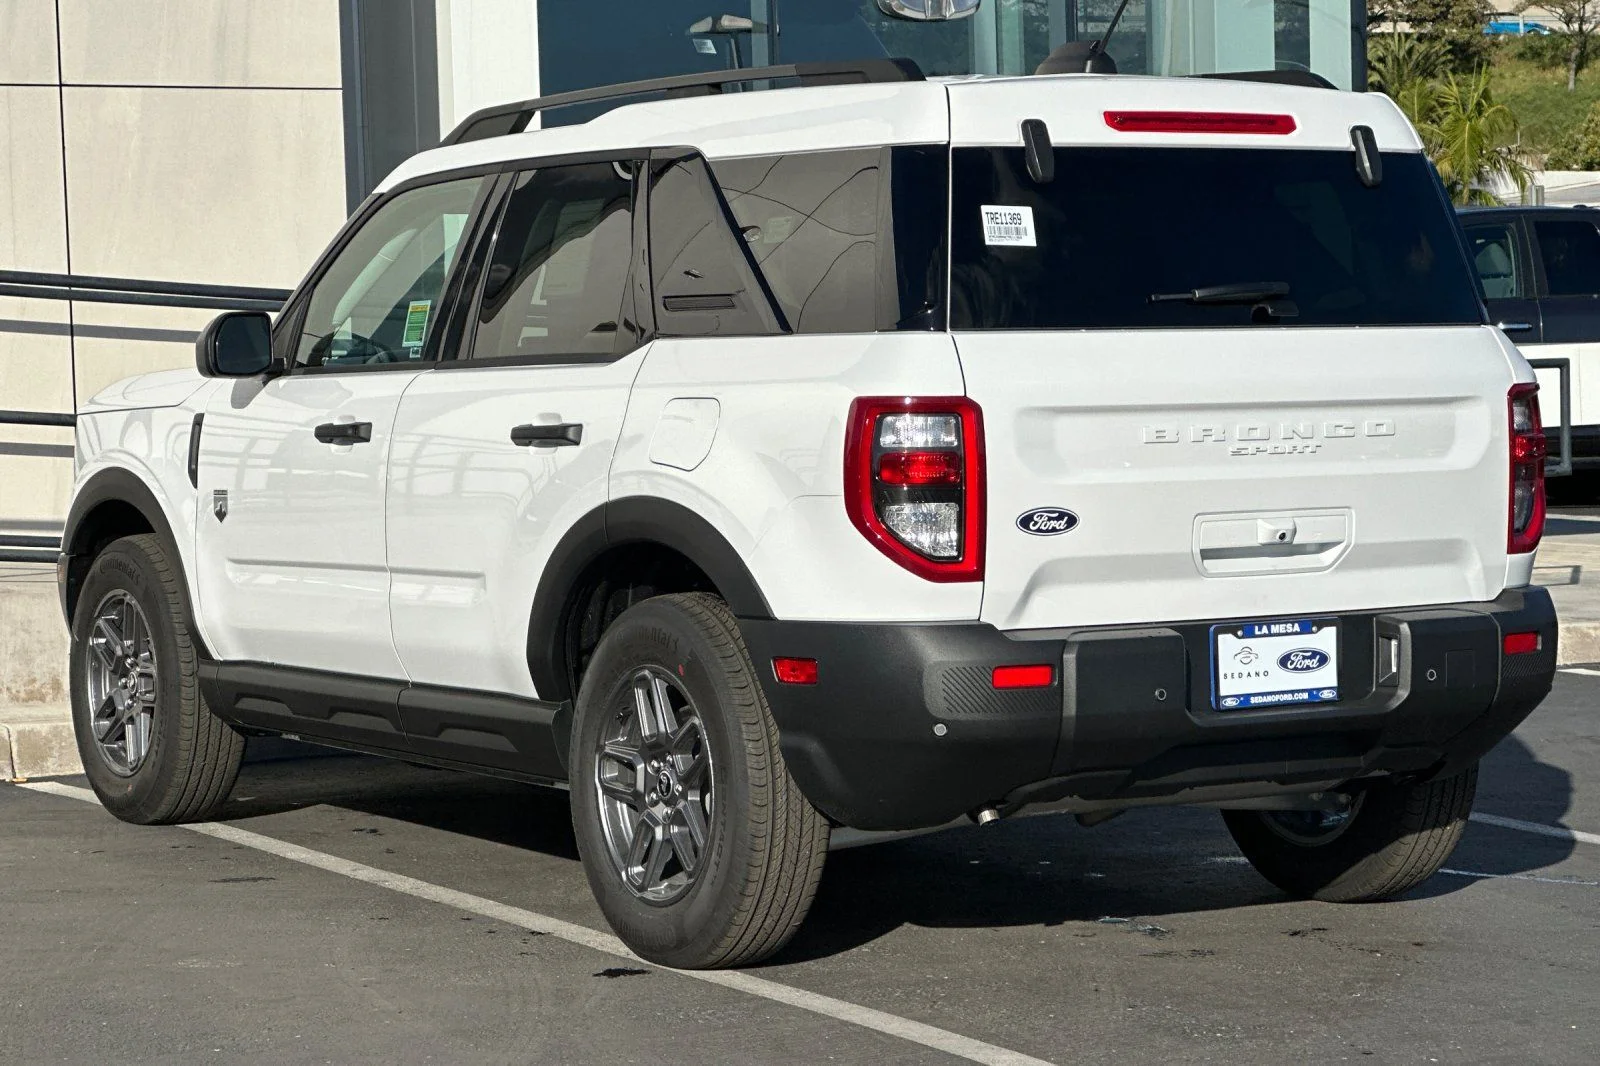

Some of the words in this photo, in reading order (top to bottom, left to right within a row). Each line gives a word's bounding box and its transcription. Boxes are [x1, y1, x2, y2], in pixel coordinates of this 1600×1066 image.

[985, 211, 1022, 226] TRE11369
[1142, 420, 1396, 444] BRONCO
[1229, 445, 1322, 456] SPORT
[1030, 512, 1068, 531] Ford
[1254, 624, 1269, 635] LA
[1271, 622, 1301, 634] MESA
[1287, 651, 1320, 669] Ford
[1223, 670, 1269, 680] SEDANO
[1250, 692, 1309, 704] SEDANOFORD.COM
